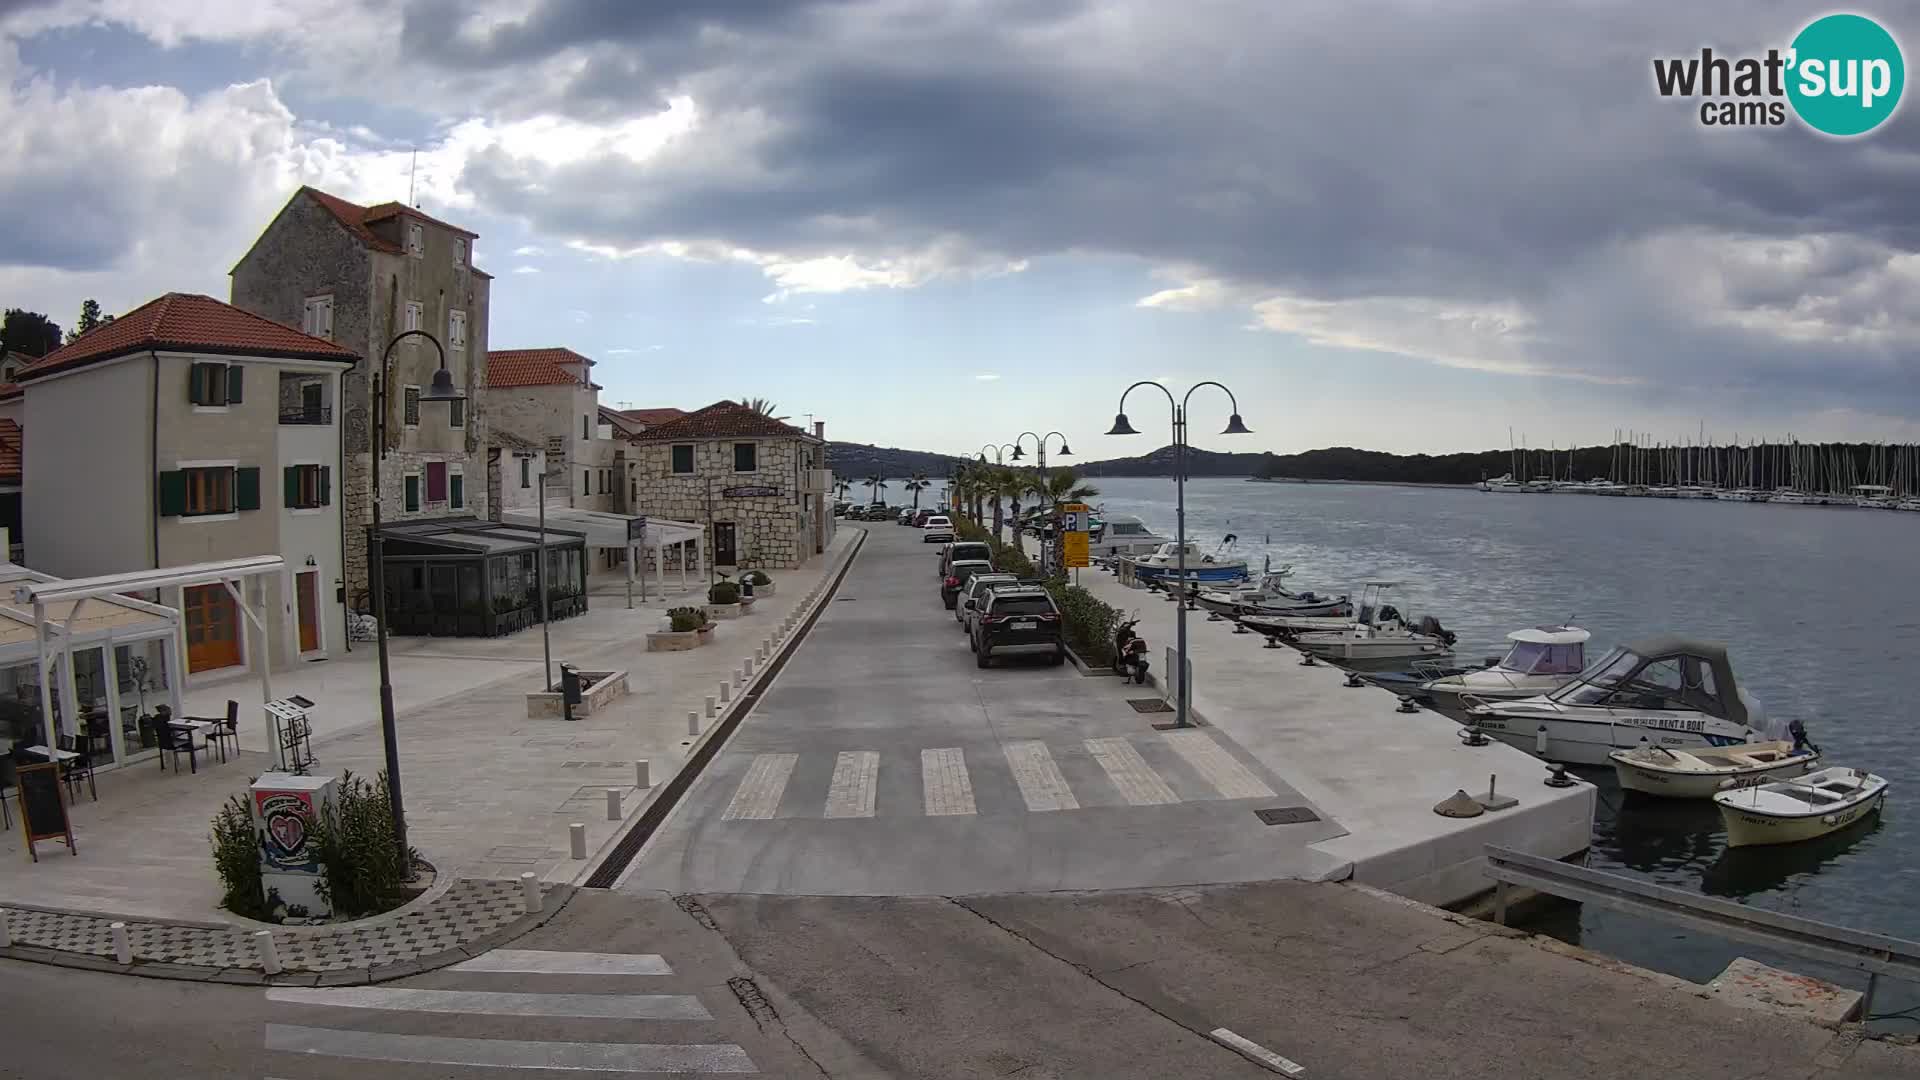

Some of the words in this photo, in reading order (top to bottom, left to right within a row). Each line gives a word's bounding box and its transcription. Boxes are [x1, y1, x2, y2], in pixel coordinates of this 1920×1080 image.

[1066, 514, 1075, 529] P
[1660, 719, 1678, 729] RENT
[1680, 720, 1685, 729] A
[1686, 720, 1706, 732] BOAT
